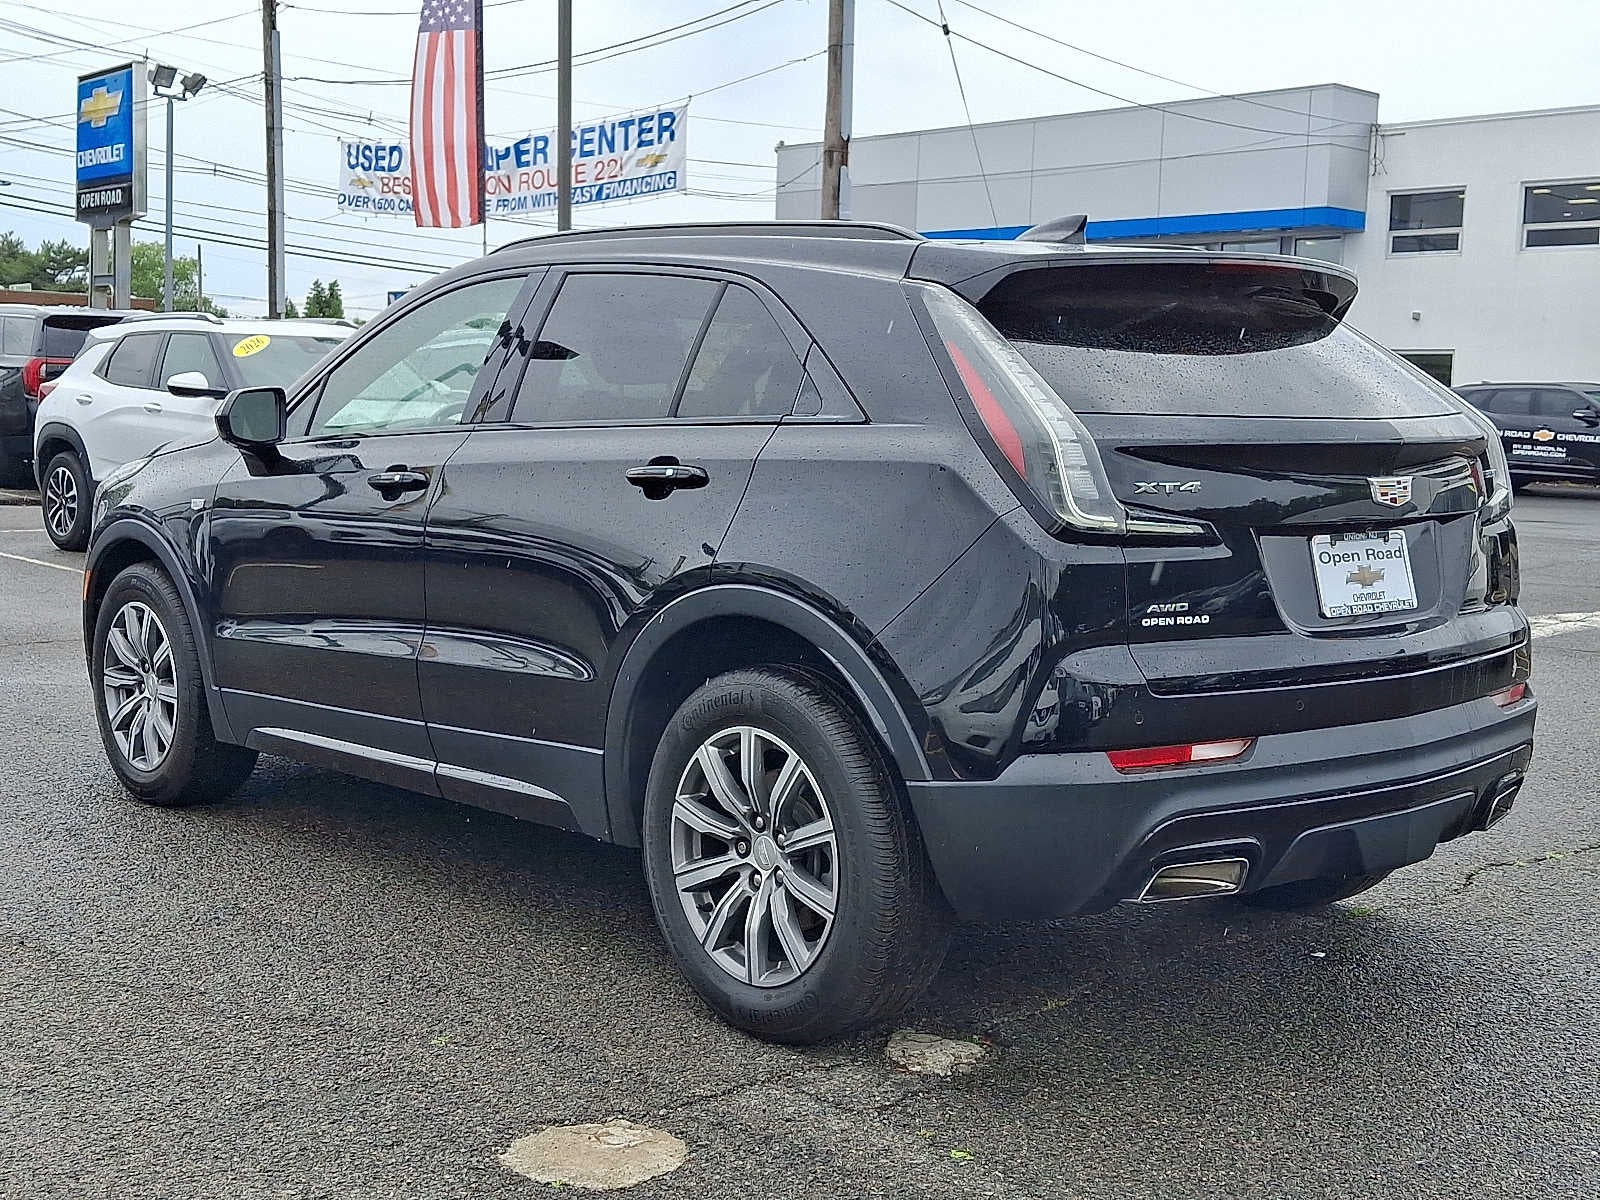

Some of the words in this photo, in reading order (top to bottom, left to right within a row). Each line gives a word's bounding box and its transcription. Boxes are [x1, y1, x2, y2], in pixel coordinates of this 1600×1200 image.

[78, 144, 125, 168] CHEVROLET
[347, 143, 403, 172] USED
[485, 135, 549, 171] UPER
[380, 176, 412, 195] BES
[486, 174, 512, 195] ON
[518, 163, 587, 192] ROUE
[594, 156, 623, 181] 22!
[80, 193, 101, 208] OPEN
[100, 189, 122, 207] ROAD
[337, 193, 370, 209] OVER
[372, 197, 396, 211] 1500
[496, 196, 528, 212] FROM
[602, 172, 675, 199] FINANCING
[1504, 430, 1531, 439] ROAD
[1556, 433, 1600, 443] CHEVROLE
[1134, 481, 1202, 495] XT4
[1318, 550, 1361, 566] Open
[1365, 546, 1403, 561] Road
[1352, 591, 1386, 603] CHEVROLET
[1146, 602, 1189, 614] AWD
[1331, 606, 1351, 617] OPEN
[1352, 604, 1374, 614] ROAD
[1374, 599, 1415, 611] CHEVROLET
[1141, 617, 1175, 627] OPEN
[1176, 615, 1210, 625] ROAD
